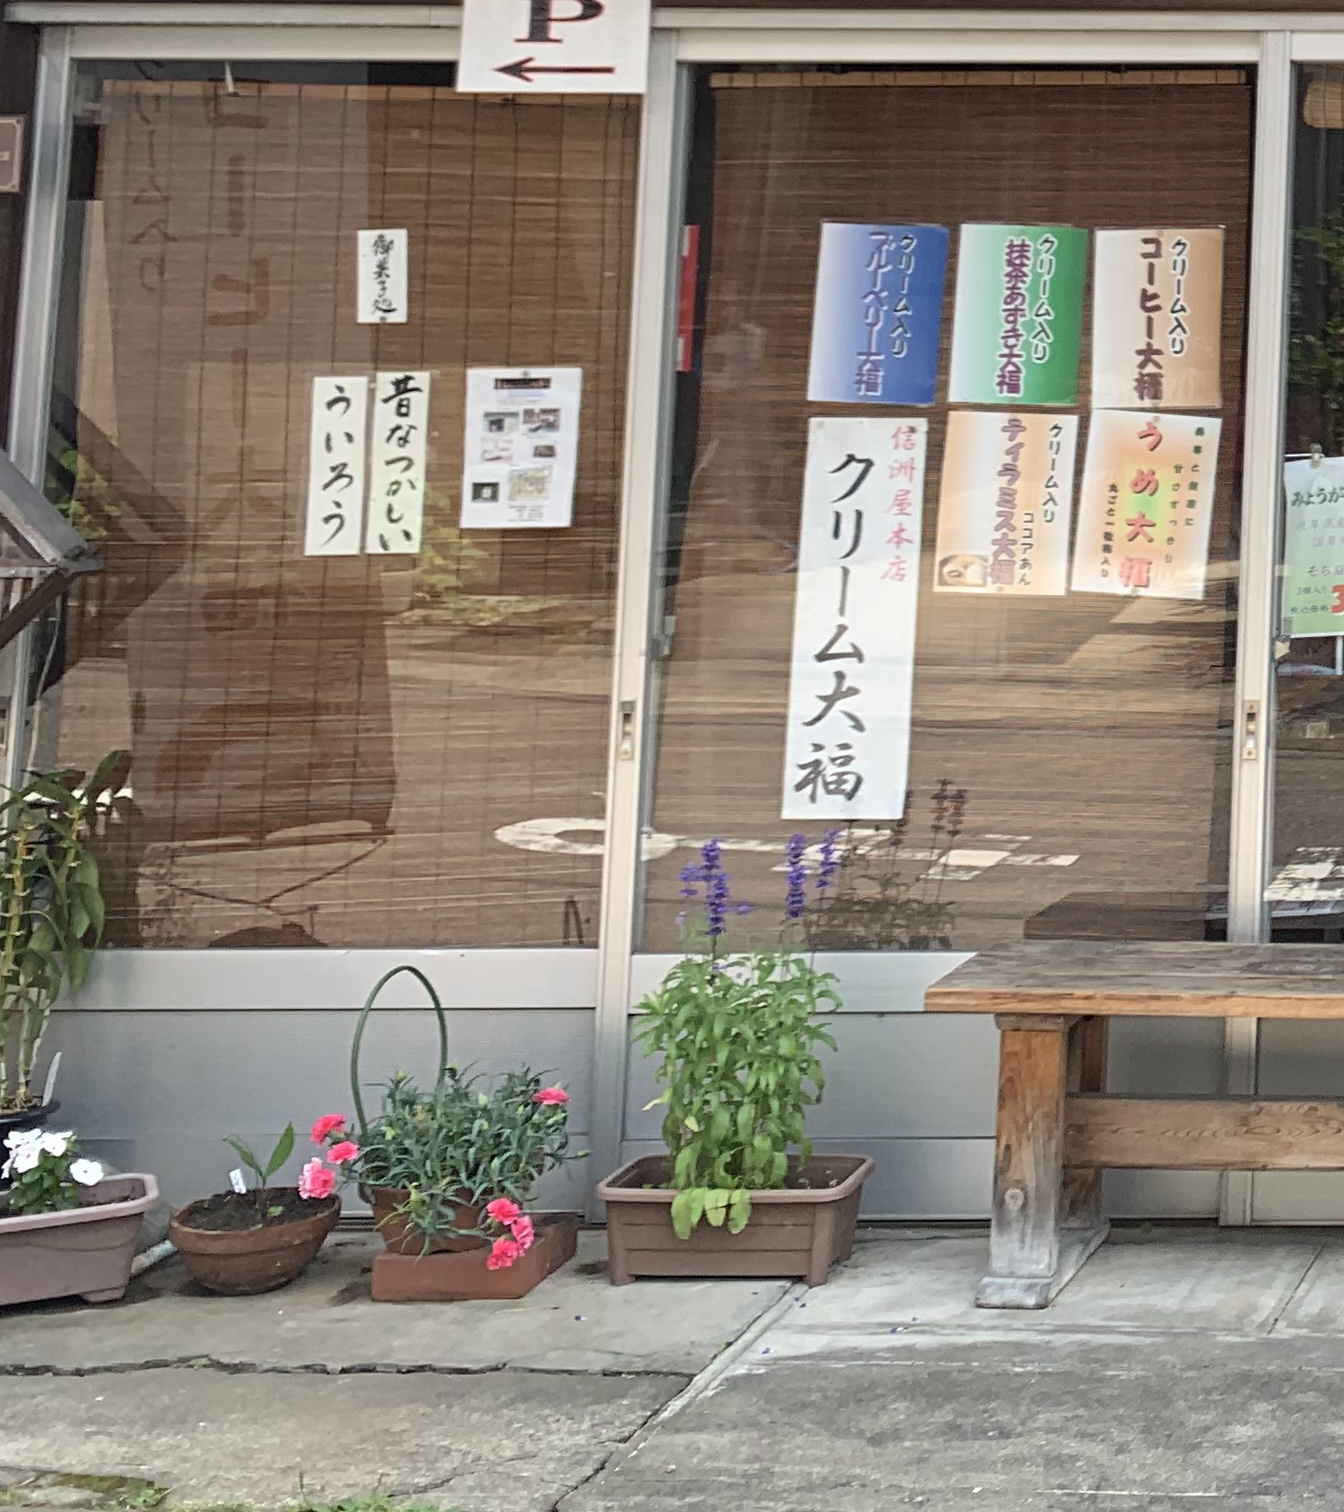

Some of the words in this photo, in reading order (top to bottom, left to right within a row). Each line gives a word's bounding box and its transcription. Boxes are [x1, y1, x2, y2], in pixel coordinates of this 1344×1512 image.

[854, 229, 897, 397] ブルーベリー大福
[889, 233, 917, 358] クリーム入り
[995, 240, 1032, 396] 抹茶あずき大福
[1030, 236, 1058, 363] クリーム入り
[1132, 238, 1166, 402] コーヒー大福
[1167, 238, 1190, 356] クリーム入り
[320, 384, 355, 548] ういろう
[380, 374, 423, 552] 昔なつかしい
[986, 418, 1027, 585] ティラミス大福
[1042, 423, 1063, 523] クリーム入り
[1118, 421, 1164, 589] うめ大福
[793, 453, 875, 805] クリーム大福
[1017, 512, 1036, 586] ココアあん
